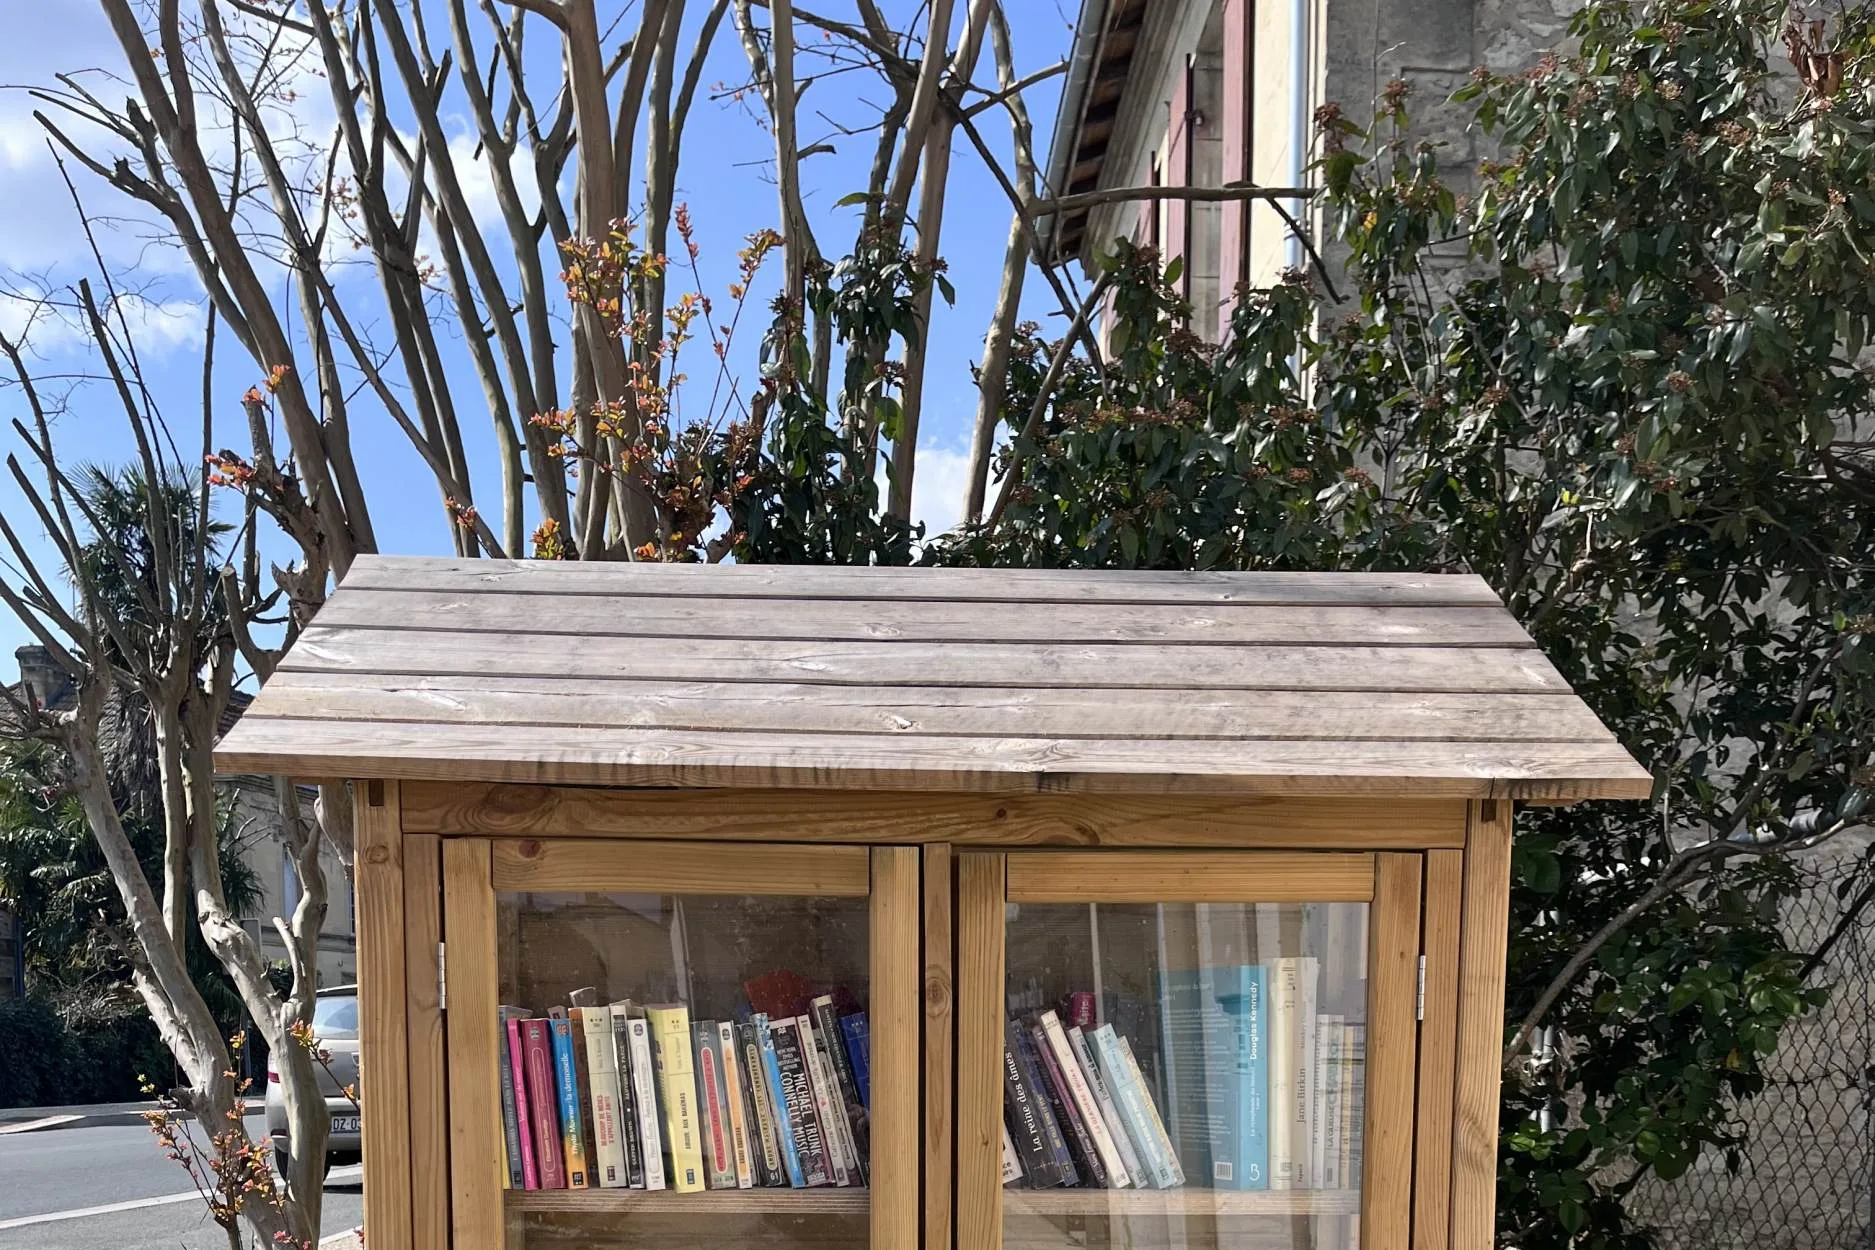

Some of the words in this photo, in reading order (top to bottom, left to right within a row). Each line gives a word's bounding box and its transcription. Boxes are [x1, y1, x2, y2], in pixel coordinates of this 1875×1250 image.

[1250, 1024, 1258, 1059] Douglas
[562, 1053, 571, 1091] demoiselle
[1006, 1053, 1019, 1080] âmes
[1016, 1084, 1026, 1102] des
[1297, 1069, 1305, 1098] Birkin
[781, 1072, 801, 1122] CONNELLY
[793, 1127, 809, 1156] MUSIC
[794, 1074, 812, 1116] MICHAEL
[805, 1123, 821, 1155] TRUNK
[1023, 1105, 1036, 1133] reine
[1297, 1103, 1306, 1123] Jane
[1033, 1136, 1042, 1151] La
